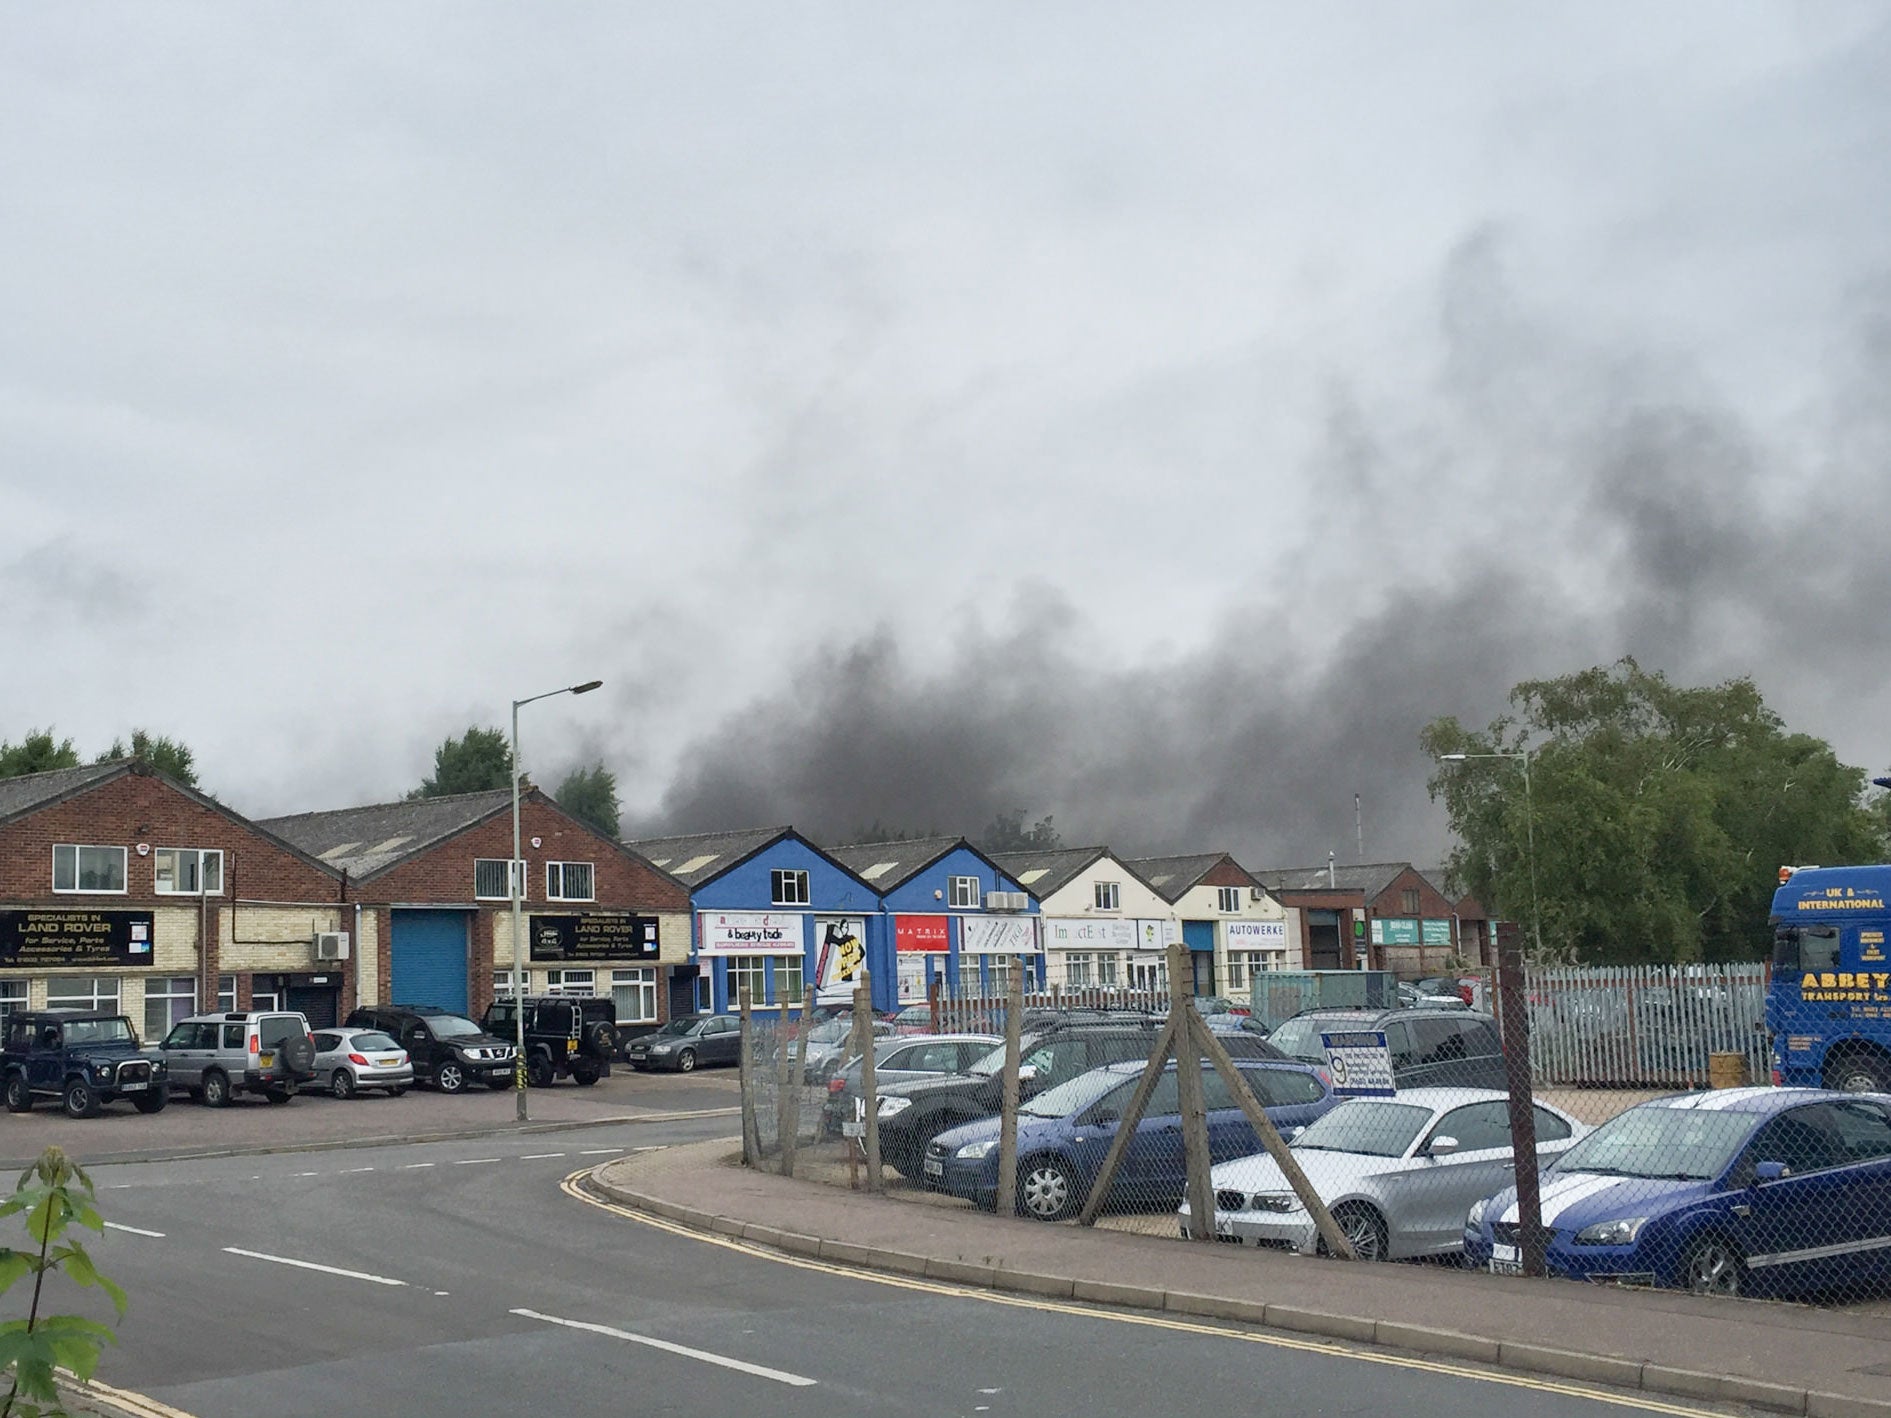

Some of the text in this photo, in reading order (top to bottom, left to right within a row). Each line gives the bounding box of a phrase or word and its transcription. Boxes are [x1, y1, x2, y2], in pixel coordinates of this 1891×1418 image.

[1826, 887, 1855, 897] UK &
[1798, 899, 1885, 910] INTERNATIONAL
[28, 914, 101, 922] SPECIALISTS IN
[18, 923, 112, 933] LAND ROVER
[575, 925, 600, 934] LAND
[603, 925, 633, 934] ROVER
[1229, 924, 1283, 935] AUTOWERKE
[19, 945, 73, 953] Accessories
[86, 945, 110, 954] Tyres
[1801, 973, 1889, 989] ABBEY
[1802, 992, 1870, 1001] TRANSPORT
